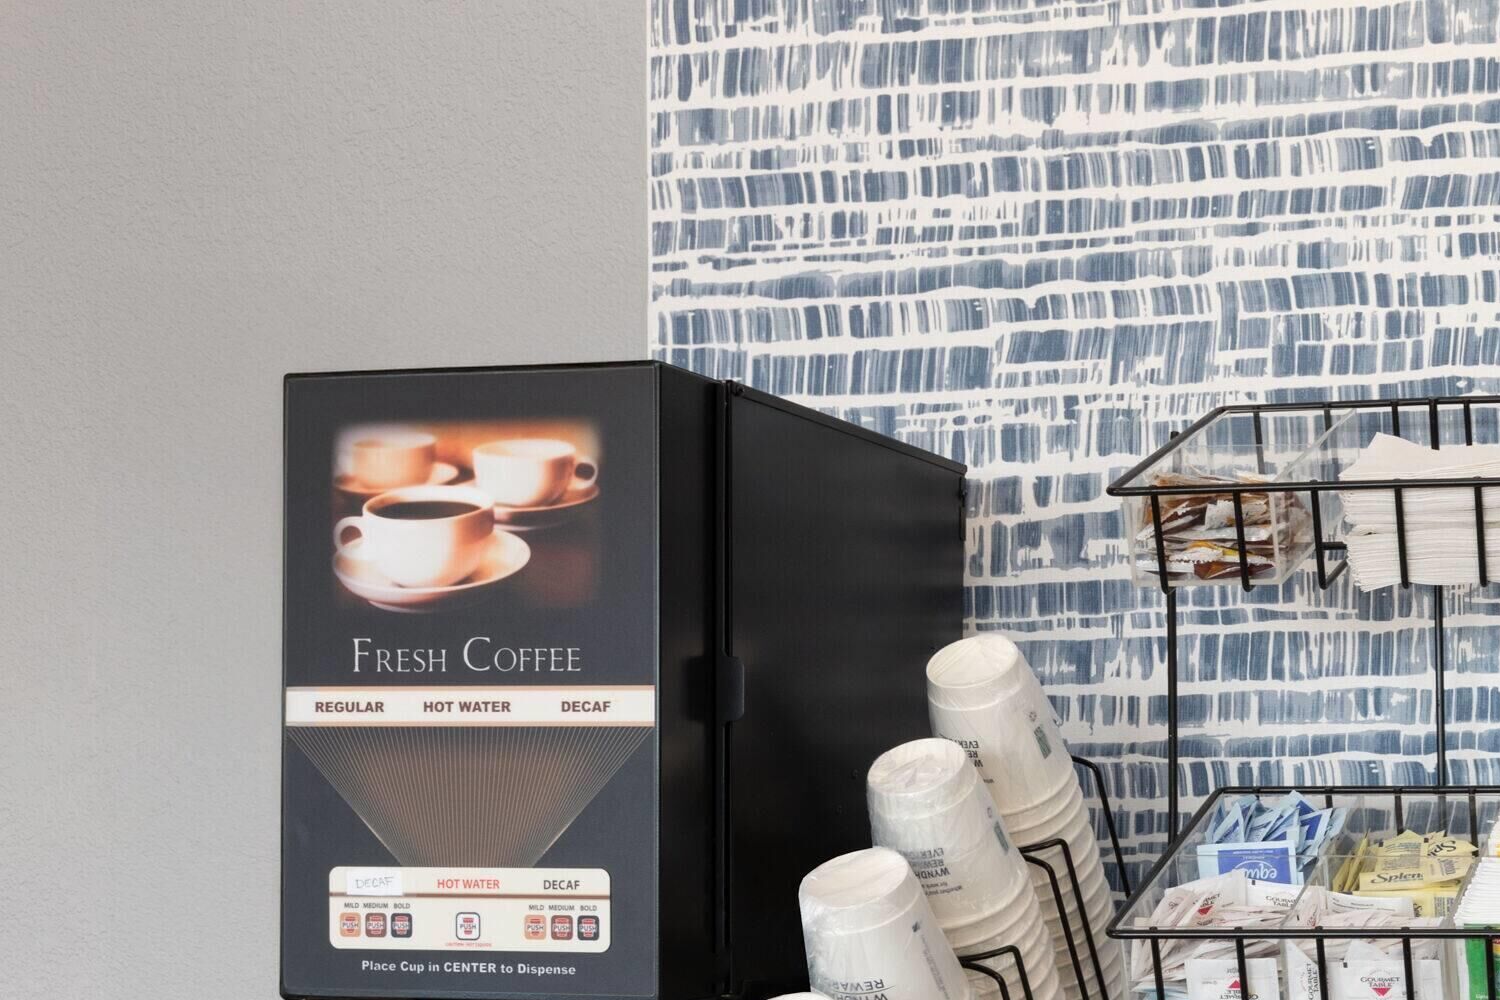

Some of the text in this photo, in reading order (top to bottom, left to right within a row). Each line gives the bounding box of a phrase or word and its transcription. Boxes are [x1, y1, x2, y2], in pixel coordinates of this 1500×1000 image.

[352, 637, 582, 673] FRESH COFFEE
[315, 701, 385, 713] REGULAR
[423, 701, 511, 713] HOT WATER
[561, 700, 611, 713] DECAF
[355, 876, 395, 890] DECAF
[437, 879, 500, 890] HOT WATER
[543, 880, 580, 890] DECAF
[342, 921, 359, 929] PUSH
[527, 924, 544, 932] PUSH
[361, 961, 576, 976] Place Cup in CENTER to Dispense
[1360, 976, 1401, 984] GOURMET
